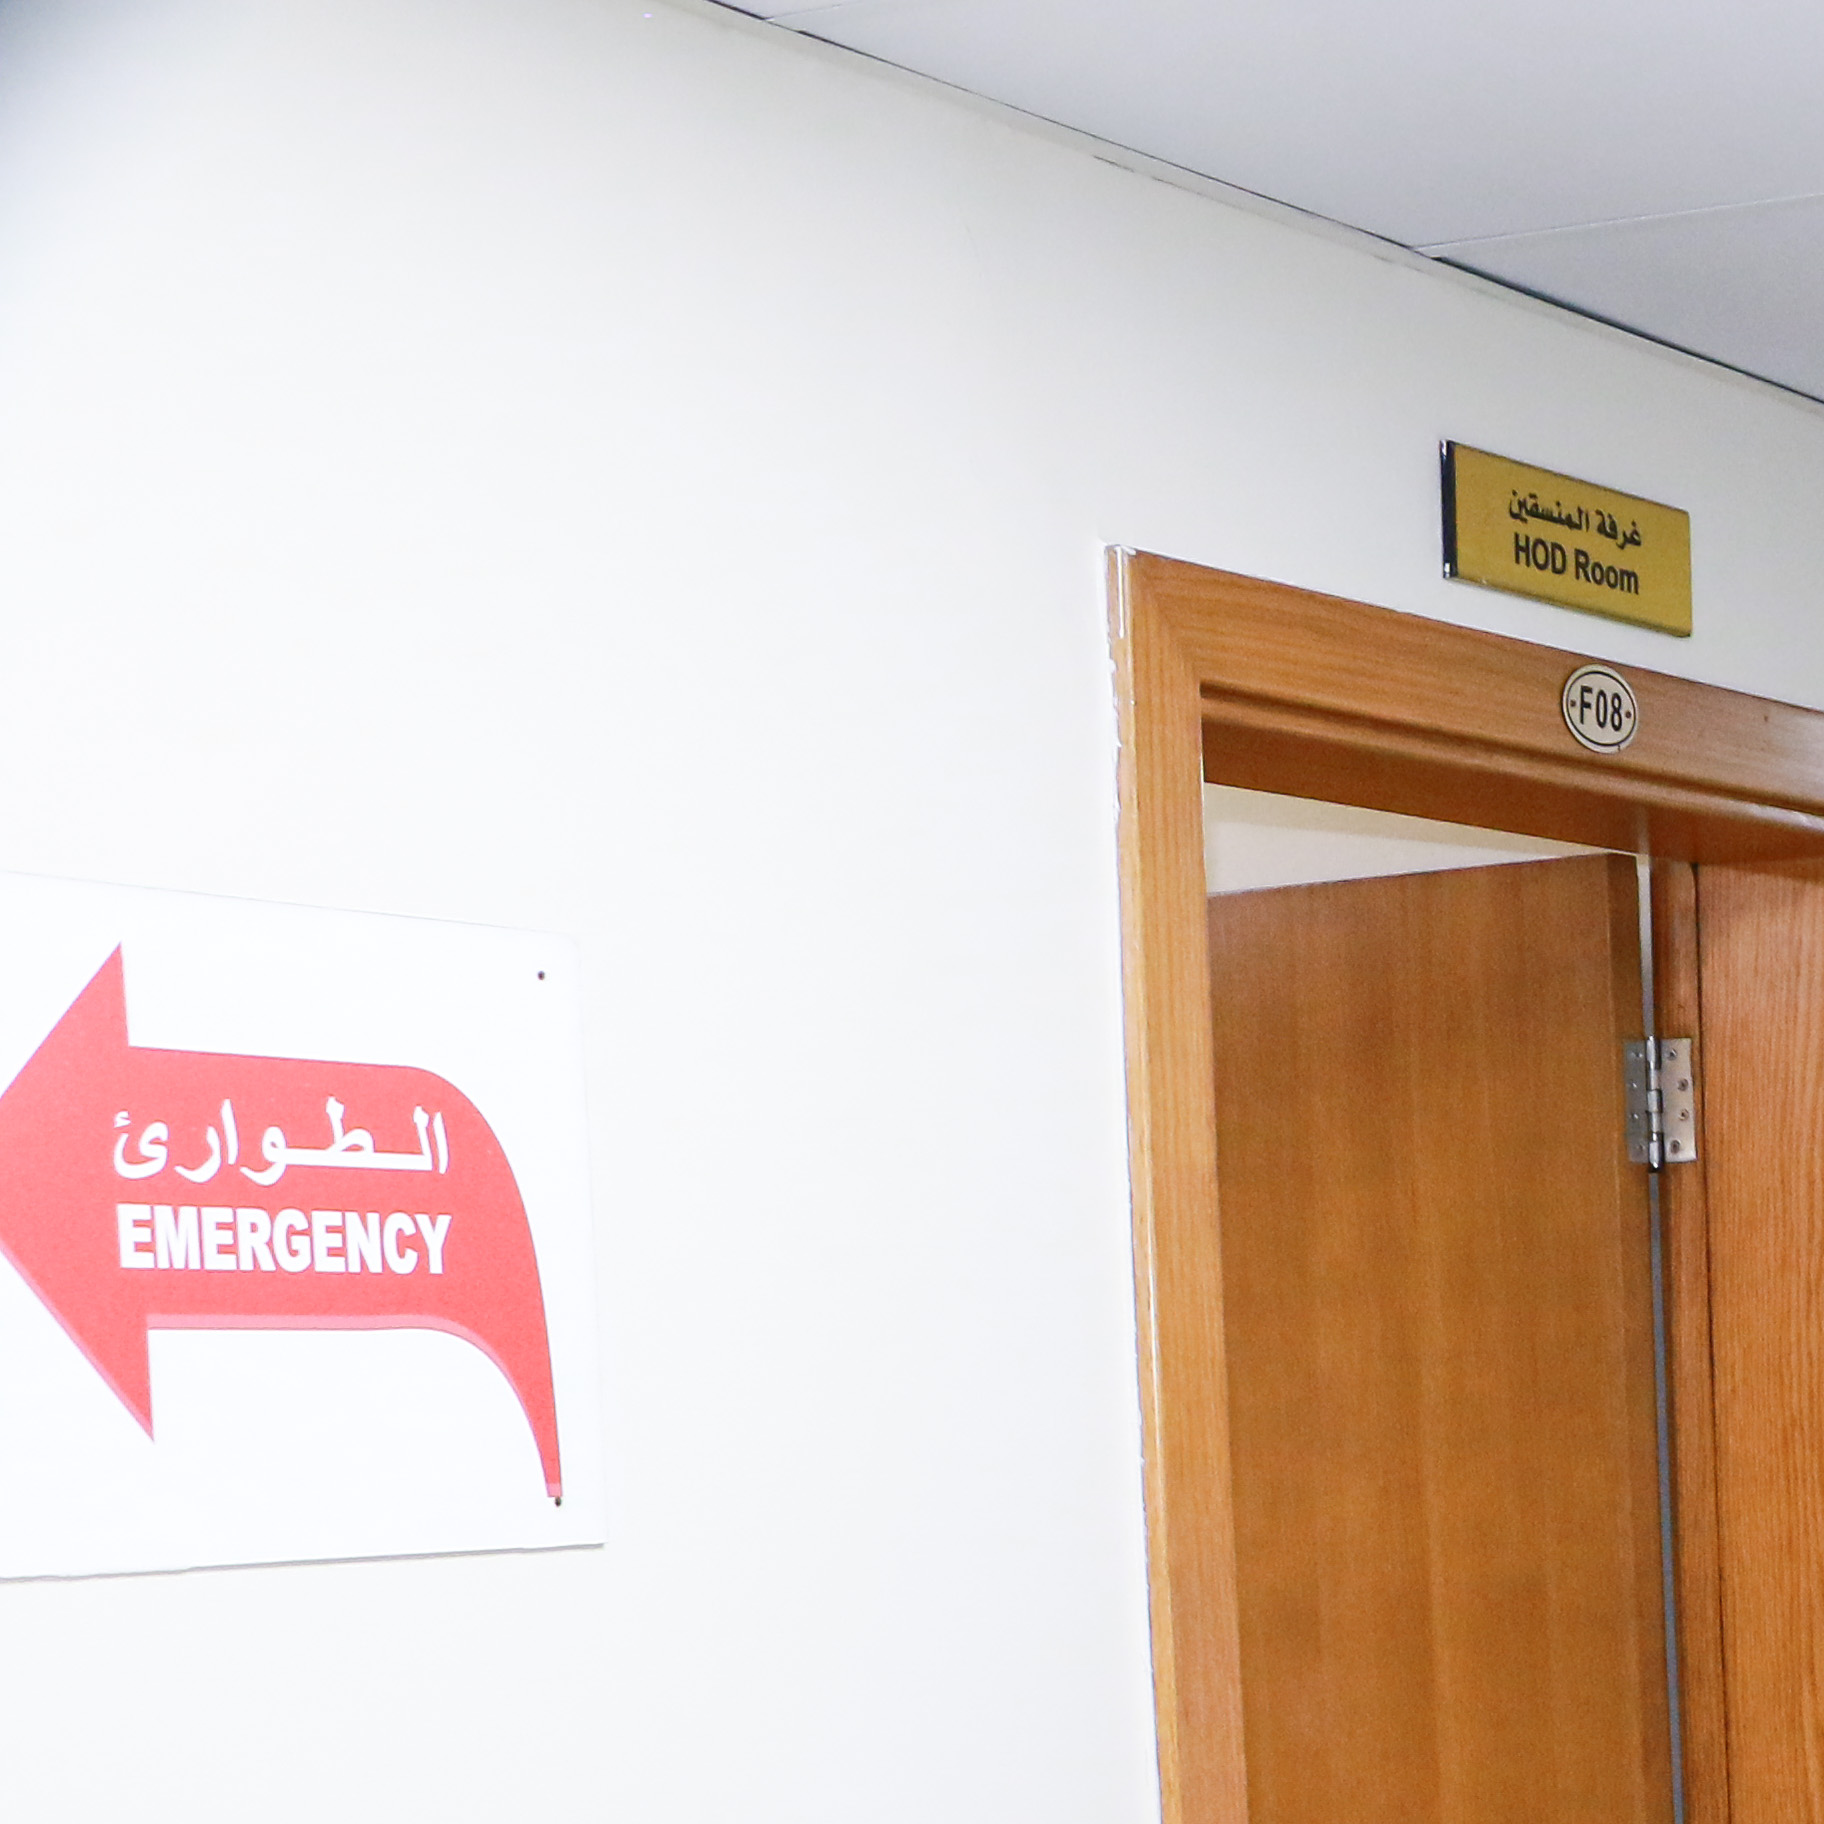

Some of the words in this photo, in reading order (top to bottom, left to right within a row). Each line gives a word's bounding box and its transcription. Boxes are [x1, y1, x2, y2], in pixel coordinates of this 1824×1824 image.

[1509, 490, 1590, 532] المنسقين
[1596, 508, 1642, 550] غرفة
[1513, 532, 1567, 575] HOD
[1575, 549, 1639, 596] Room
[1579, 685, 1623, 733] F08
[111, 1095, 451, 1187] الطوارئ
[116, 1202, 453, 1276] EMERGENCY
